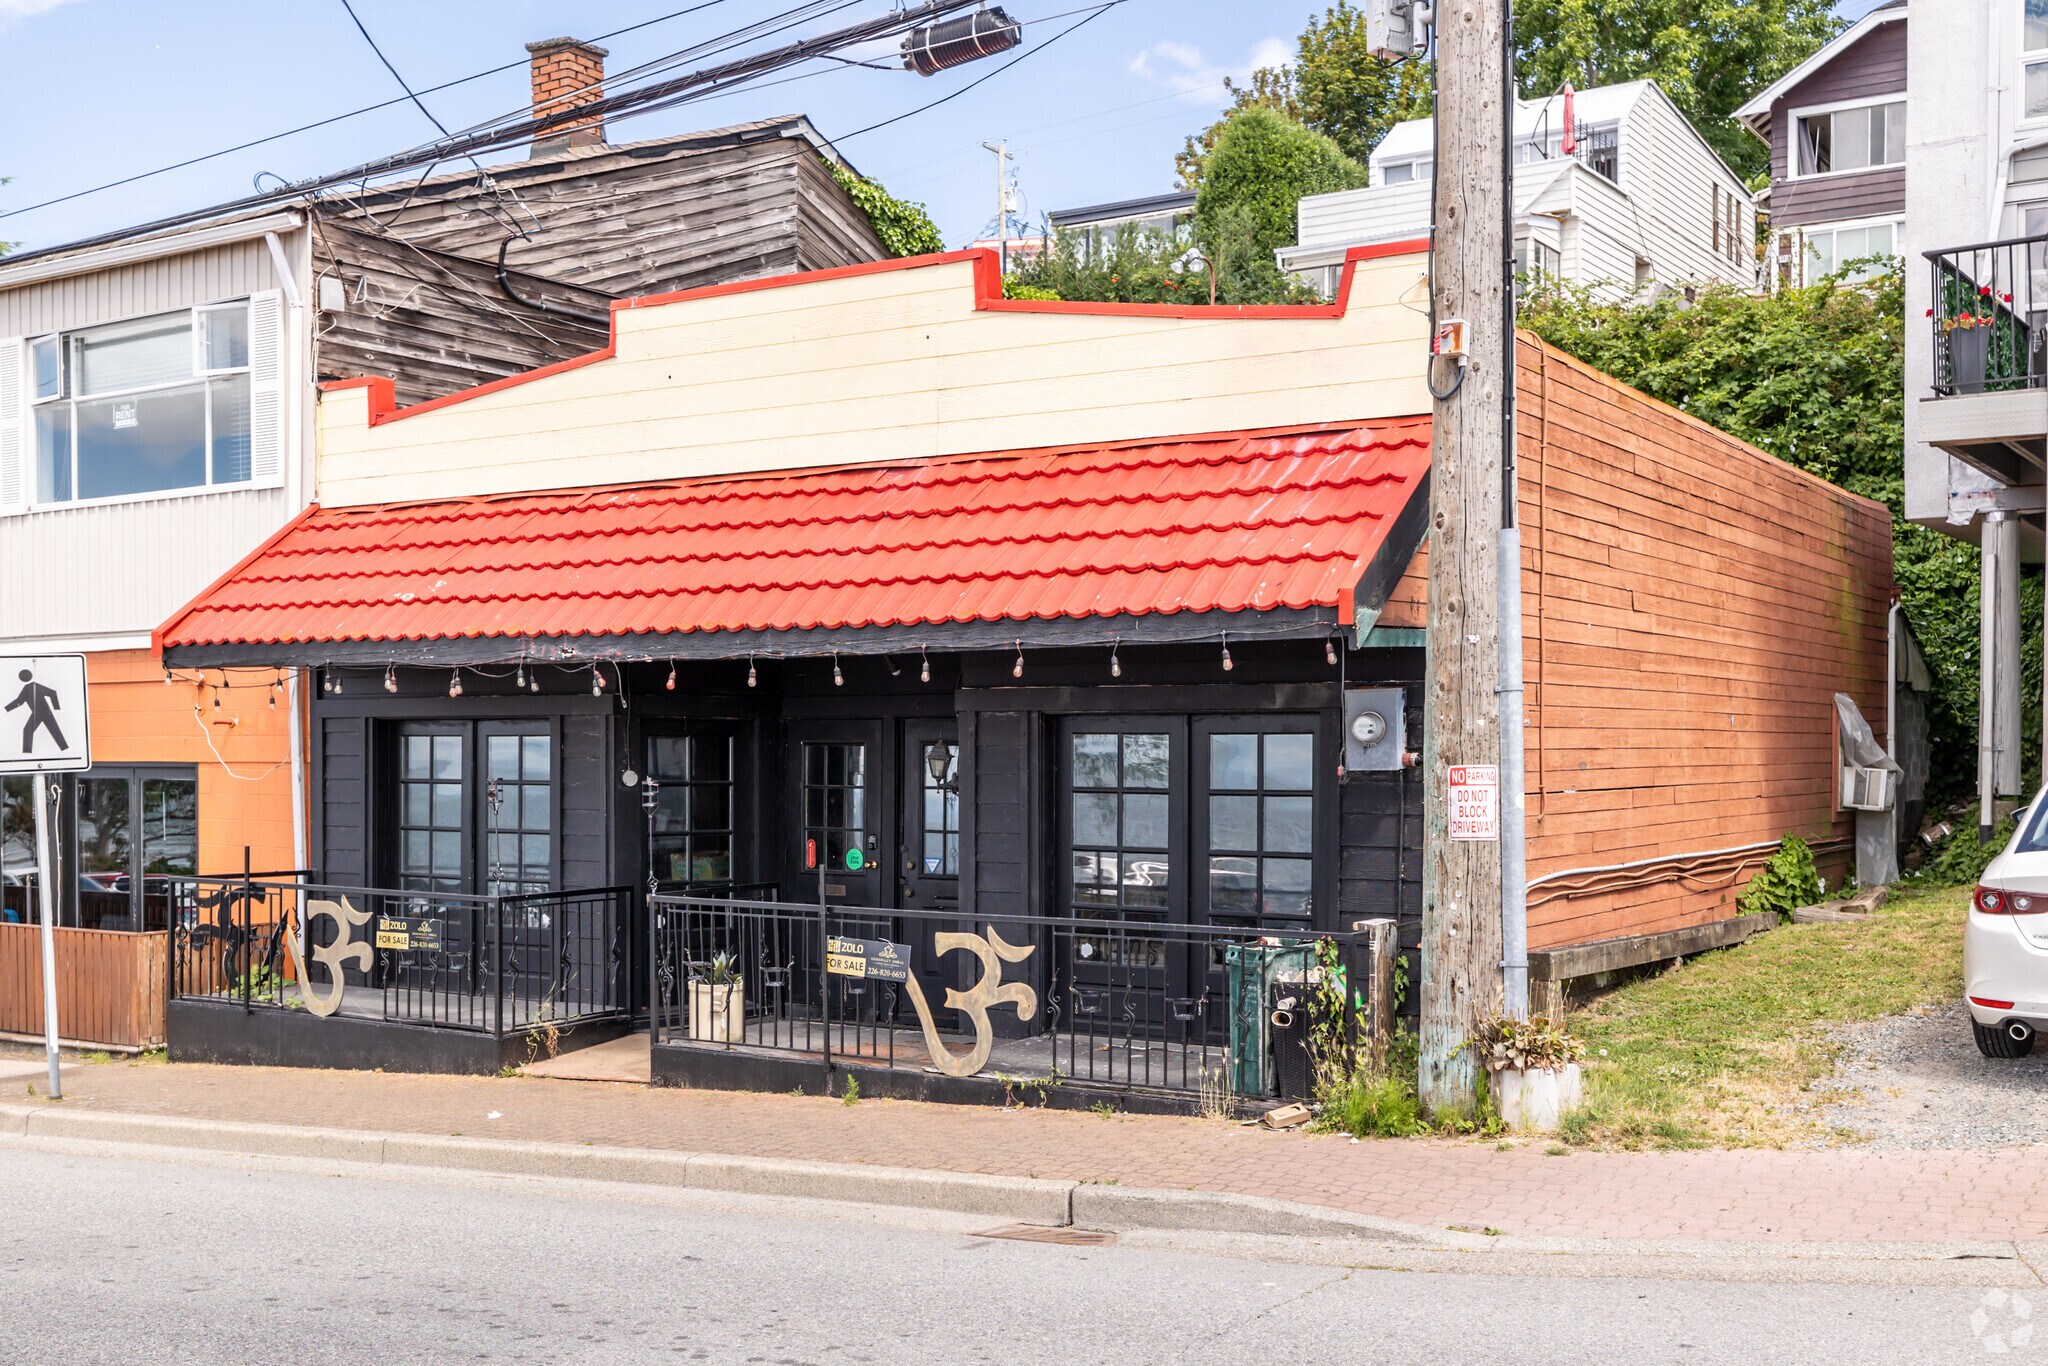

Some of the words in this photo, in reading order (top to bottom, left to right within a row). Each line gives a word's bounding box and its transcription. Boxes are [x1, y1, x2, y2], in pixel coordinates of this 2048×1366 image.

[115, 409, 136, 420] RENT
[1452, 769, 1465, 783] NO
[1467, 771, 1494, 781] PARKING
[1458, 790, 1469, 802] DO
[1471, 790, 1488, 802] NOT
[1459, 805, 1487, 818] BLOCK
[1453, 820, 1494, 833] DRIVEWAY
[390, 921, 407, 930] ZOLO
[379, 935, 391, 943] FOR
[392, 936, 407, 945] SALE
[841, 942, 864, 954] ZOLO
[844, 960, 864, 971] SALE
[867, 967, 906, 978] 226-820-6653
